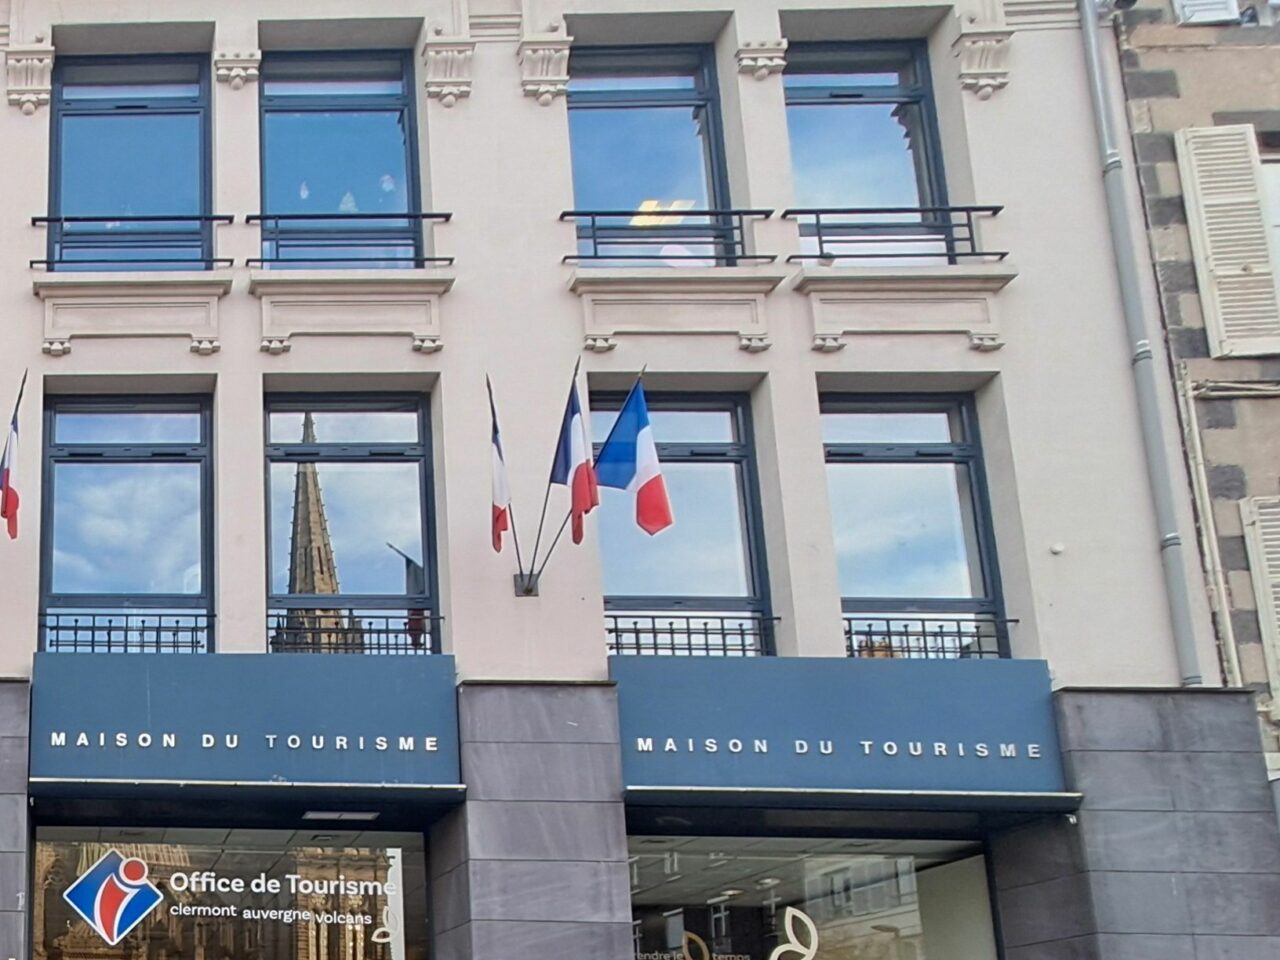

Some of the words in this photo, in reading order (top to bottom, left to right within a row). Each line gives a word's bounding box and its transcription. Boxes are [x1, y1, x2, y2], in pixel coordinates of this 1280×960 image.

[51, 732, 176, 747] MAISON
[202, 733, 239, 748] DU
[266, 734, 438, 751] TOURISME
[637, 737, 768, 753] MAISON
[795, 739, 833, 755] DU
[860, 740, 1042, 758] TOURISME
[169, 872, 245, 894] Office
[250, 873, 281, 894] de
[285, 874, 397, 896] Tourisme
[169, 902, 237, 917] clermont
[243, 909, 311, 923] auvergne
[315, 911, 373, 926] volcans
[634, 951, 670, 960] endre
